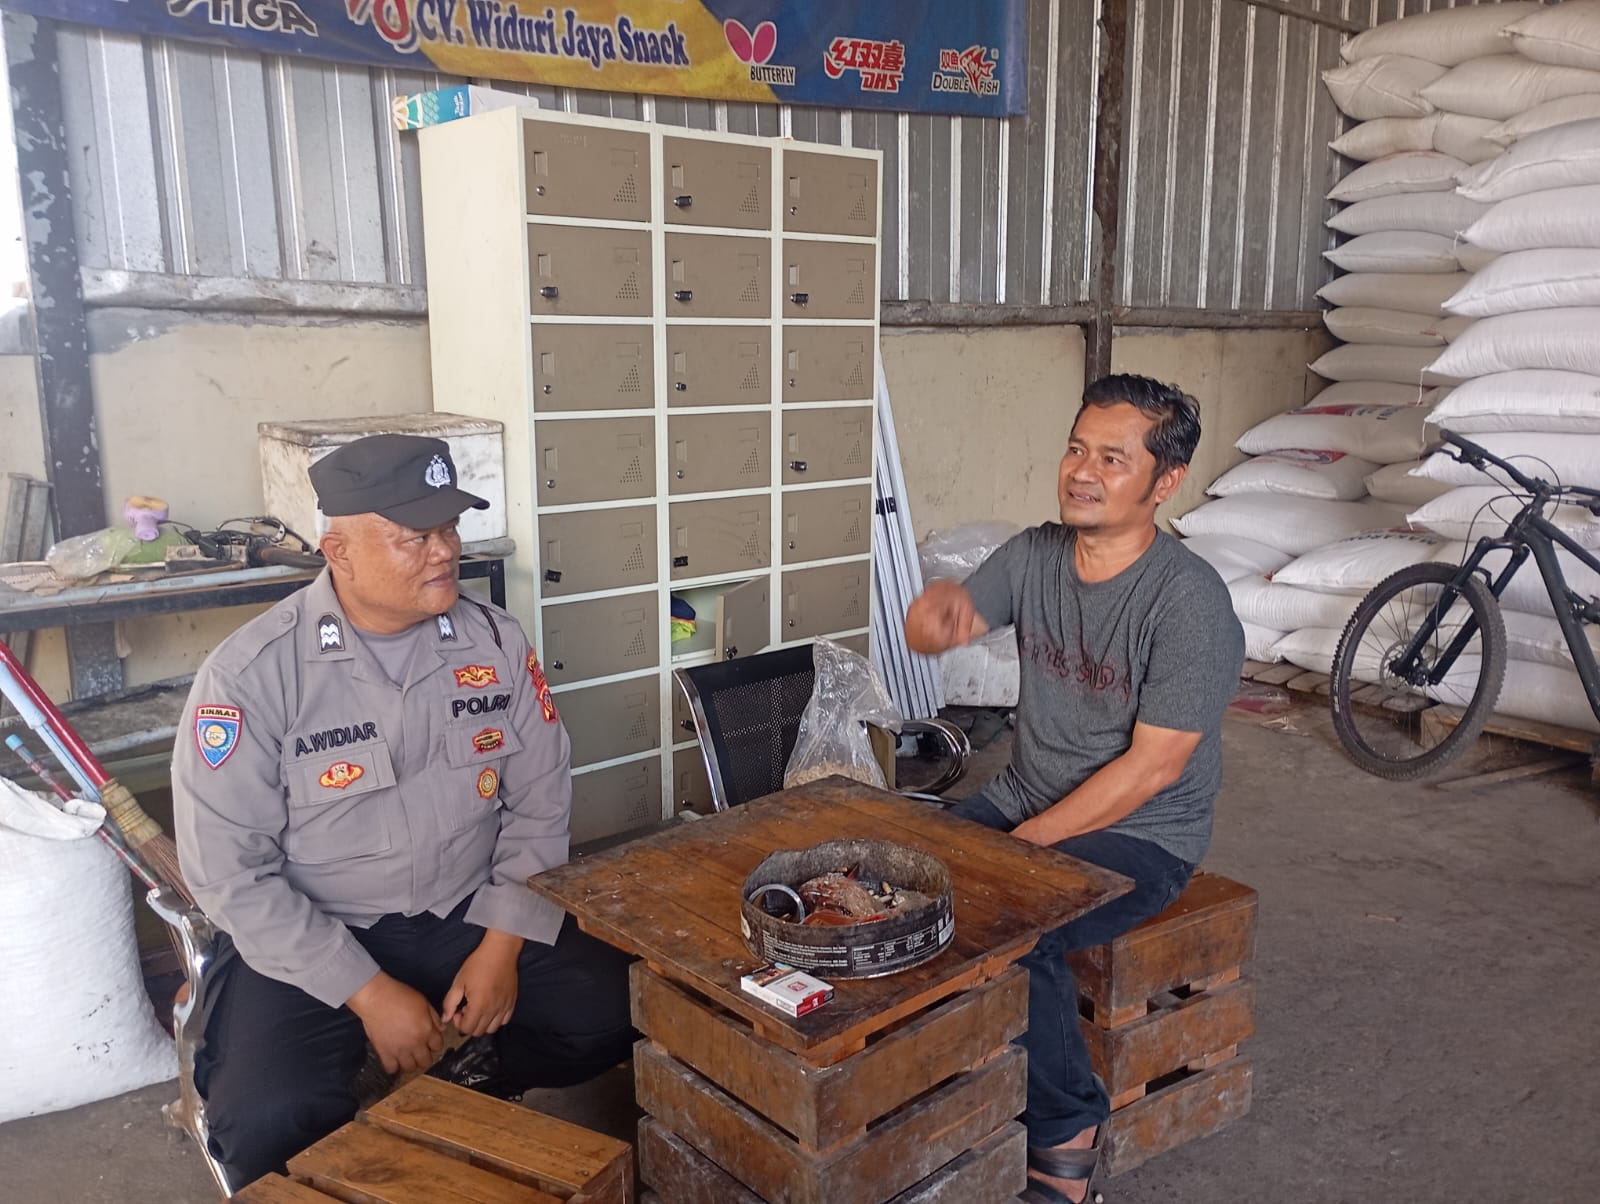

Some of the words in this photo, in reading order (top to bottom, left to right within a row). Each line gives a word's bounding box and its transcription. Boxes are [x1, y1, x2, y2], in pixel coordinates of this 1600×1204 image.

[415, 0, 464, 45] CV.
[467, 0, 559, 55] Widuri
[561, 9, 616, 69] Jaya
[617, 16, 690, 66] Snack
[750, 65, 795, 84] BUTTERFLY
[861, 71, 903, 91] DHS
[979, 79, 999, 95] FISH
[295, 721, 379, 757] A.WIDIAR
